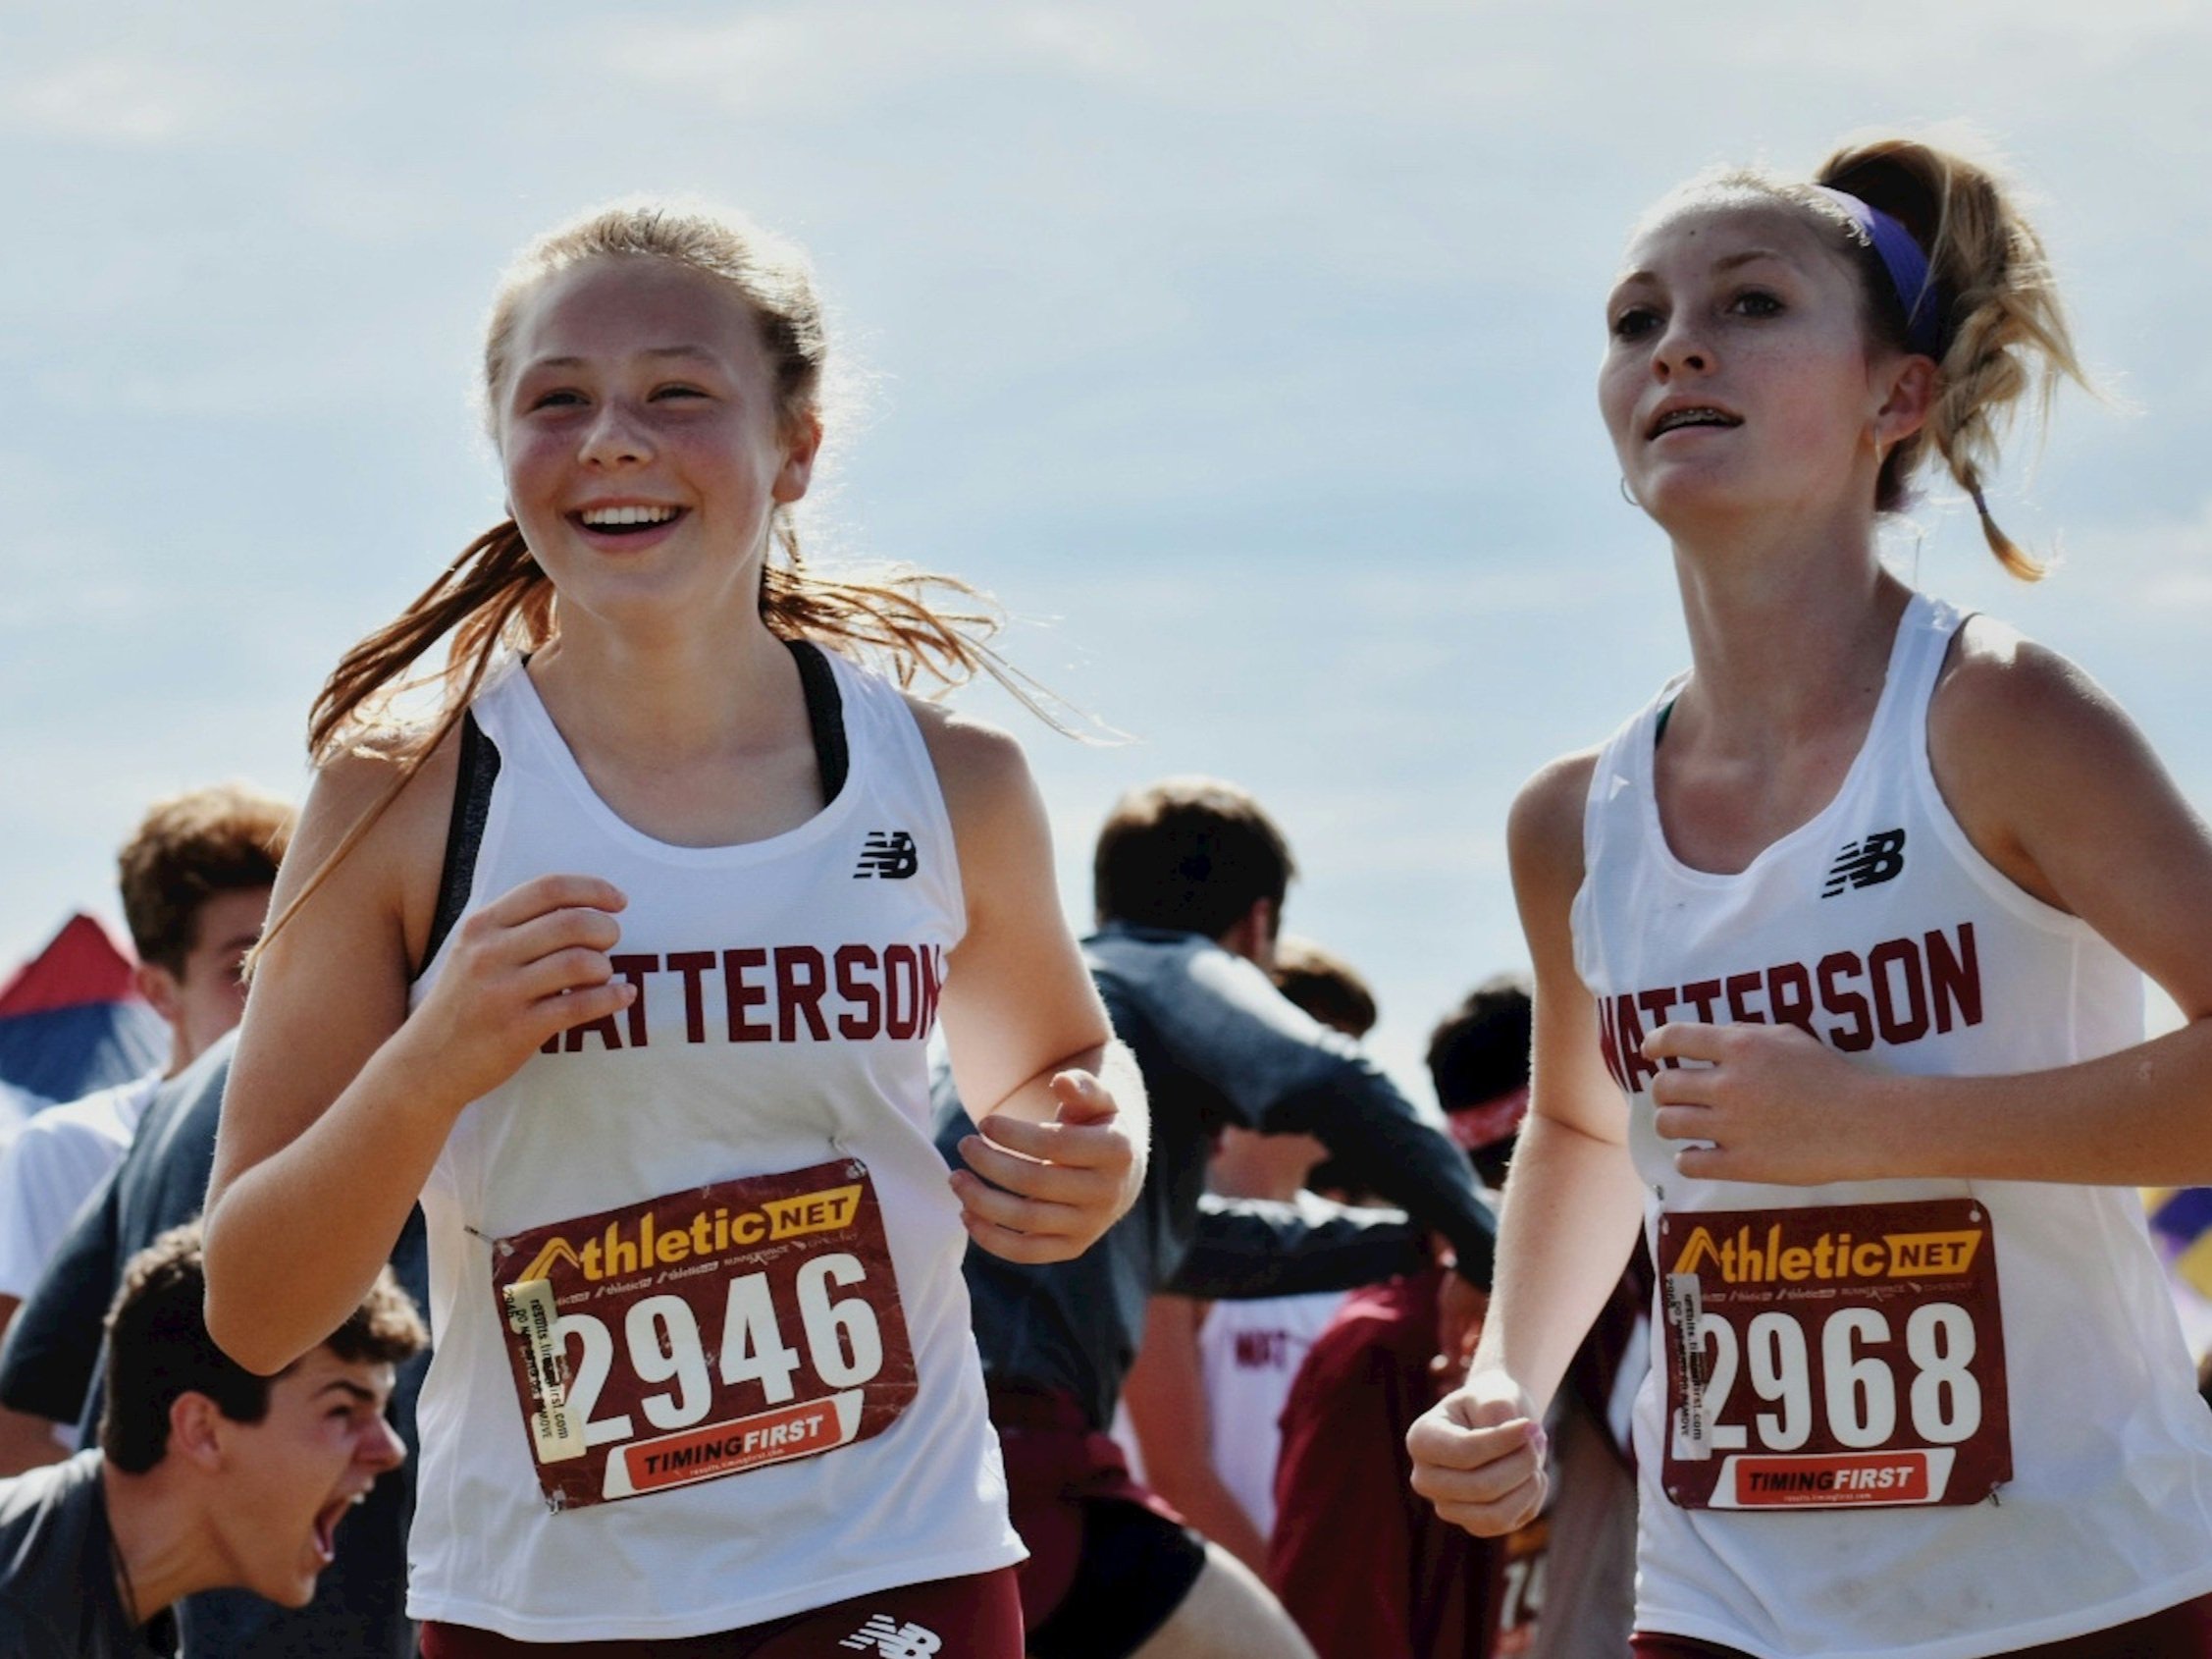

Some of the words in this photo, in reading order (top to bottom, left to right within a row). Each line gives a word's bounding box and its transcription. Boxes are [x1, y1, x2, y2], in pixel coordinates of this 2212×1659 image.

[540, 943, 942, 1054] ATTERSON
[779, 1197, 851, 1231] NET
[1898, 1241, 1968, 1267] NET
[552, 1252, 883, 1448] 2946
[1700, 1302, 1982, 1451] 2968
[644, 1414, 824, 1475] TIMINGFIRST
[1749, 1467, 1915, 1492] TIMINGFIRST
